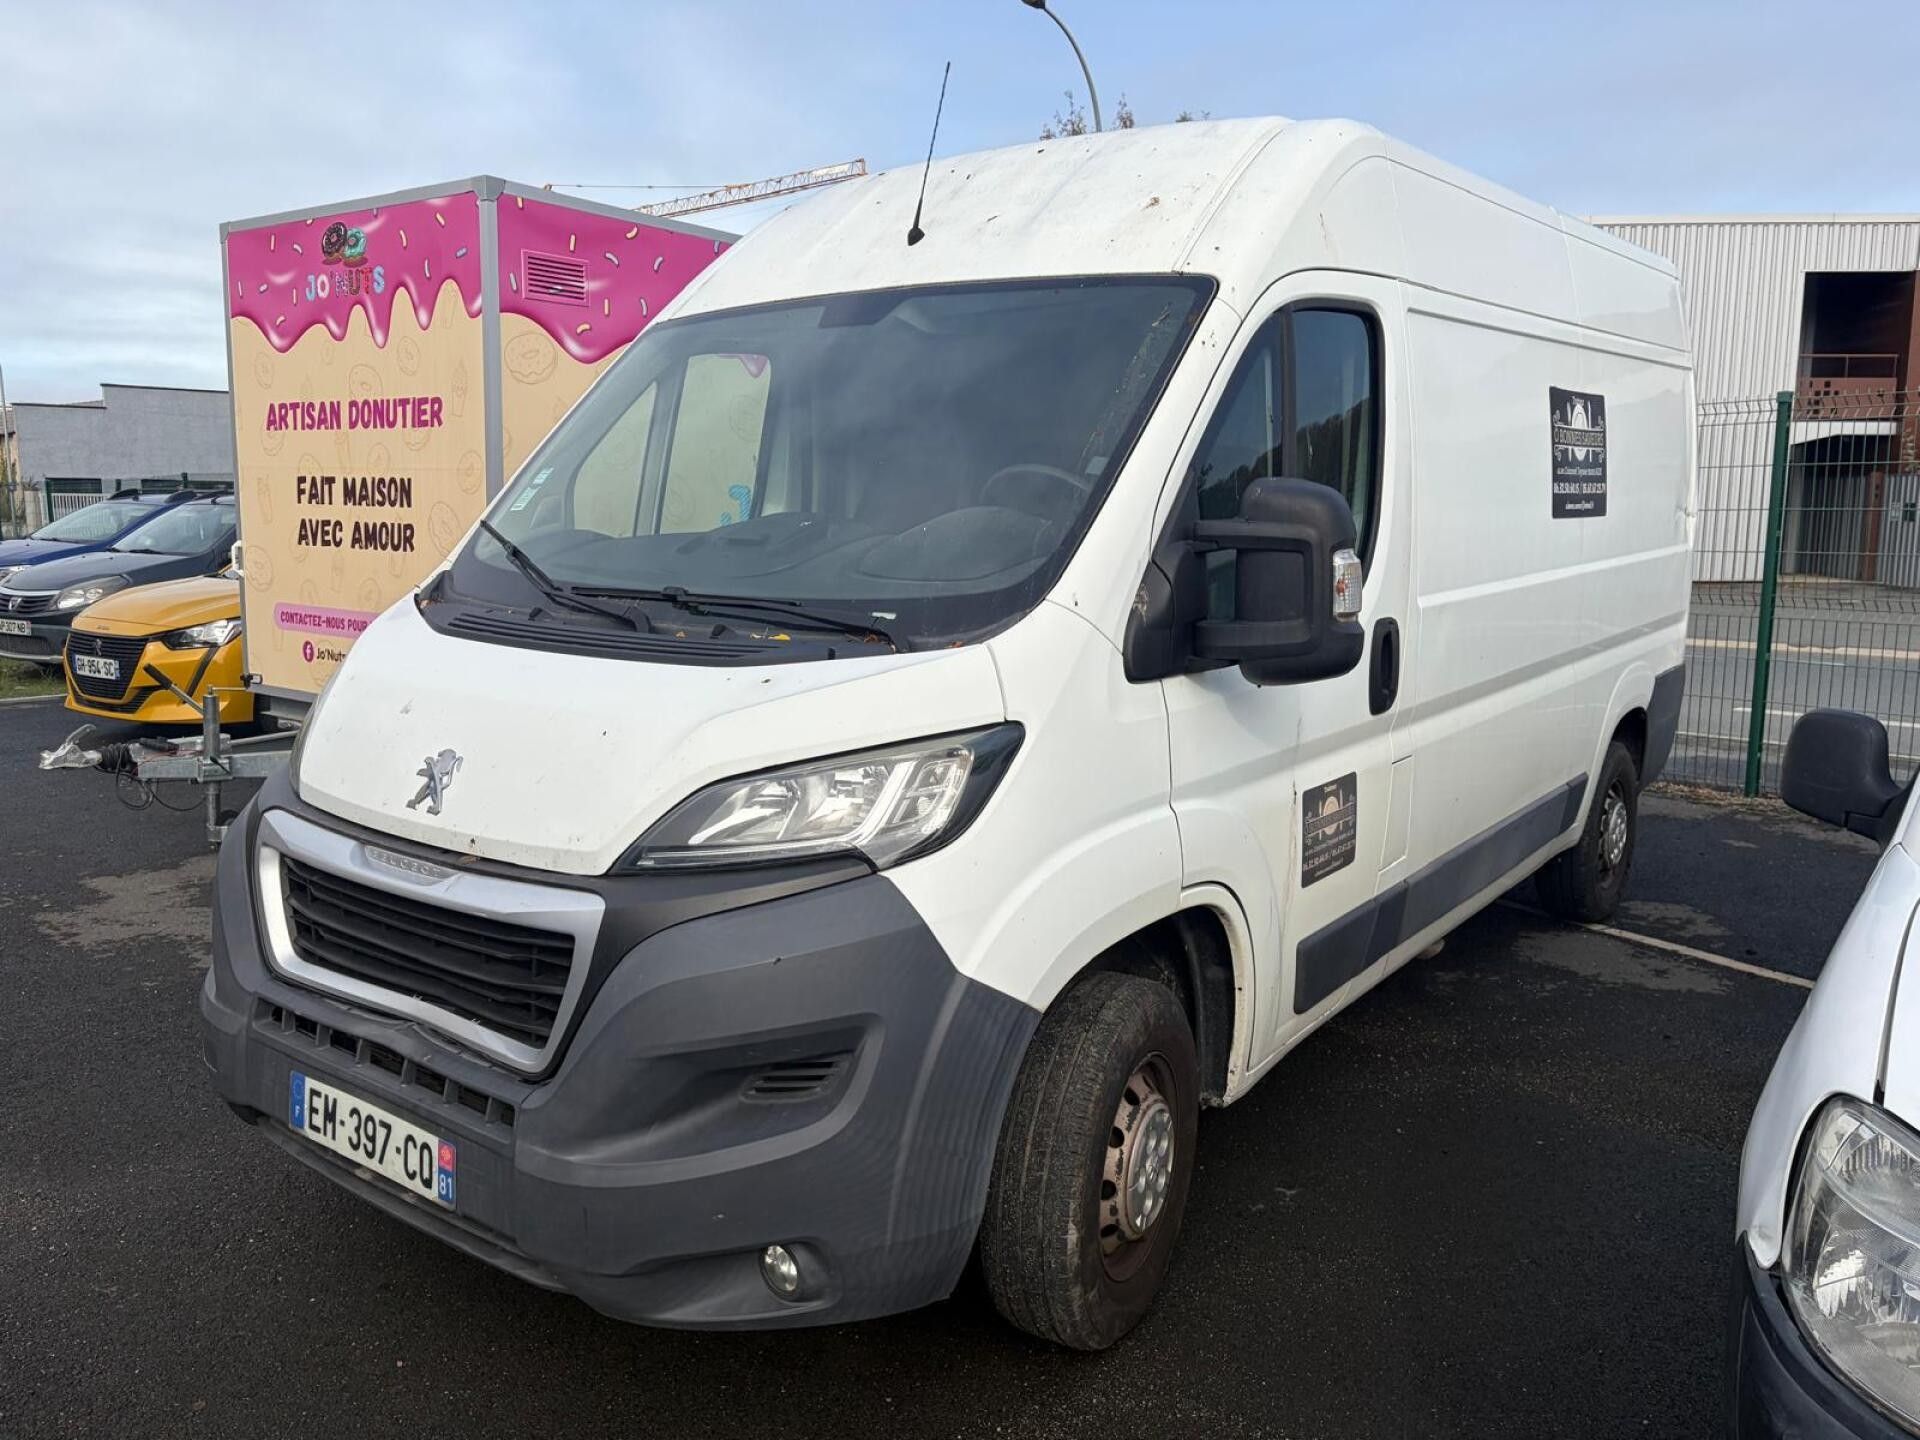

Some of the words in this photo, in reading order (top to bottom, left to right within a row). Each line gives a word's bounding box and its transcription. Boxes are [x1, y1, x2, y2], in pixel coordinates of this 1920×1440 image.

[266, 400, 342, 431] ARTISAN
[349, 396, 443, 430] DONUTIER
[296, 475, 336, 505] FAIT
[343, 477, 412, 508] MAISON
[297, 518, 343, 548] AVEC
[351, 521, 415, 552] AMOUR
[280, 611, 345, 630] CONTACTEZ-NOUS
[347, 619, 368, 632] POUR
[308, 1087, 433, 1190] EM-397-CQ
[439, 1174, 453, 1199] 81
